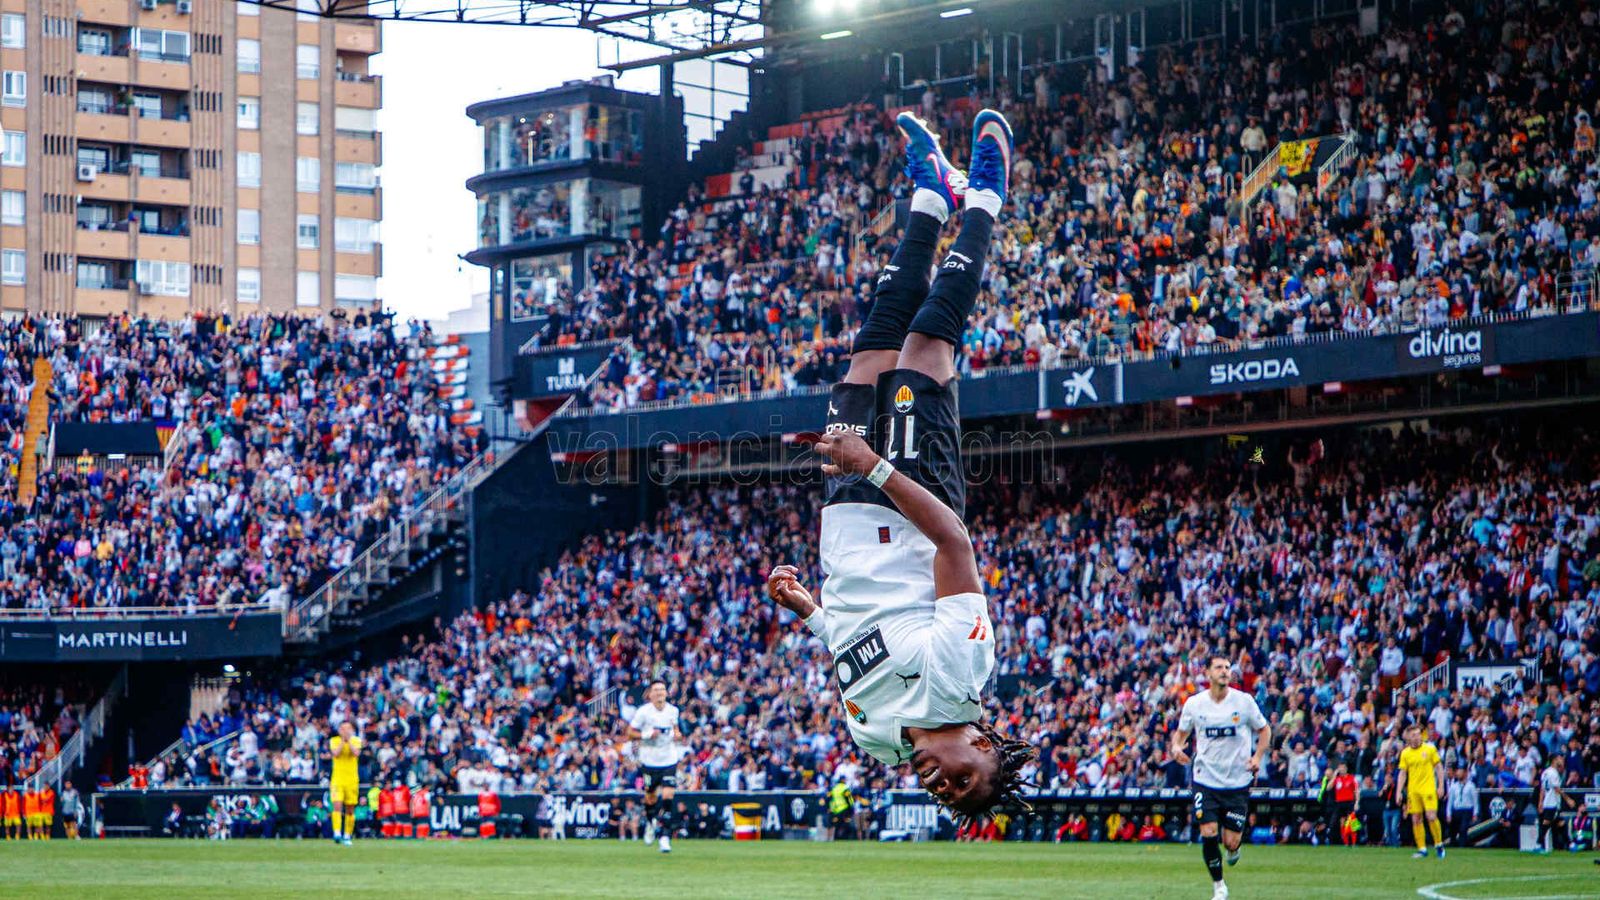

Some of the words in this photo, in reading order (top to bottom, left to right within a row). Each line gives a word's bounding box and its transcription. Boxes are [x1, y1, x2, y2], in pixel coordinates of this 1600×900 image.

[1409, 329, 1481, 358] divina
[1443, 352, 1481, 368] seguros
[546, 373, 587, 391] TURIA
[887, 415, 920, 460] 11
[58, 630, 188, 648] MARTINELLI
[856, 636, 884, 665] TM
[1462, 676, 1485, 690] TM
[1194, 792, 1203, 809] 2
